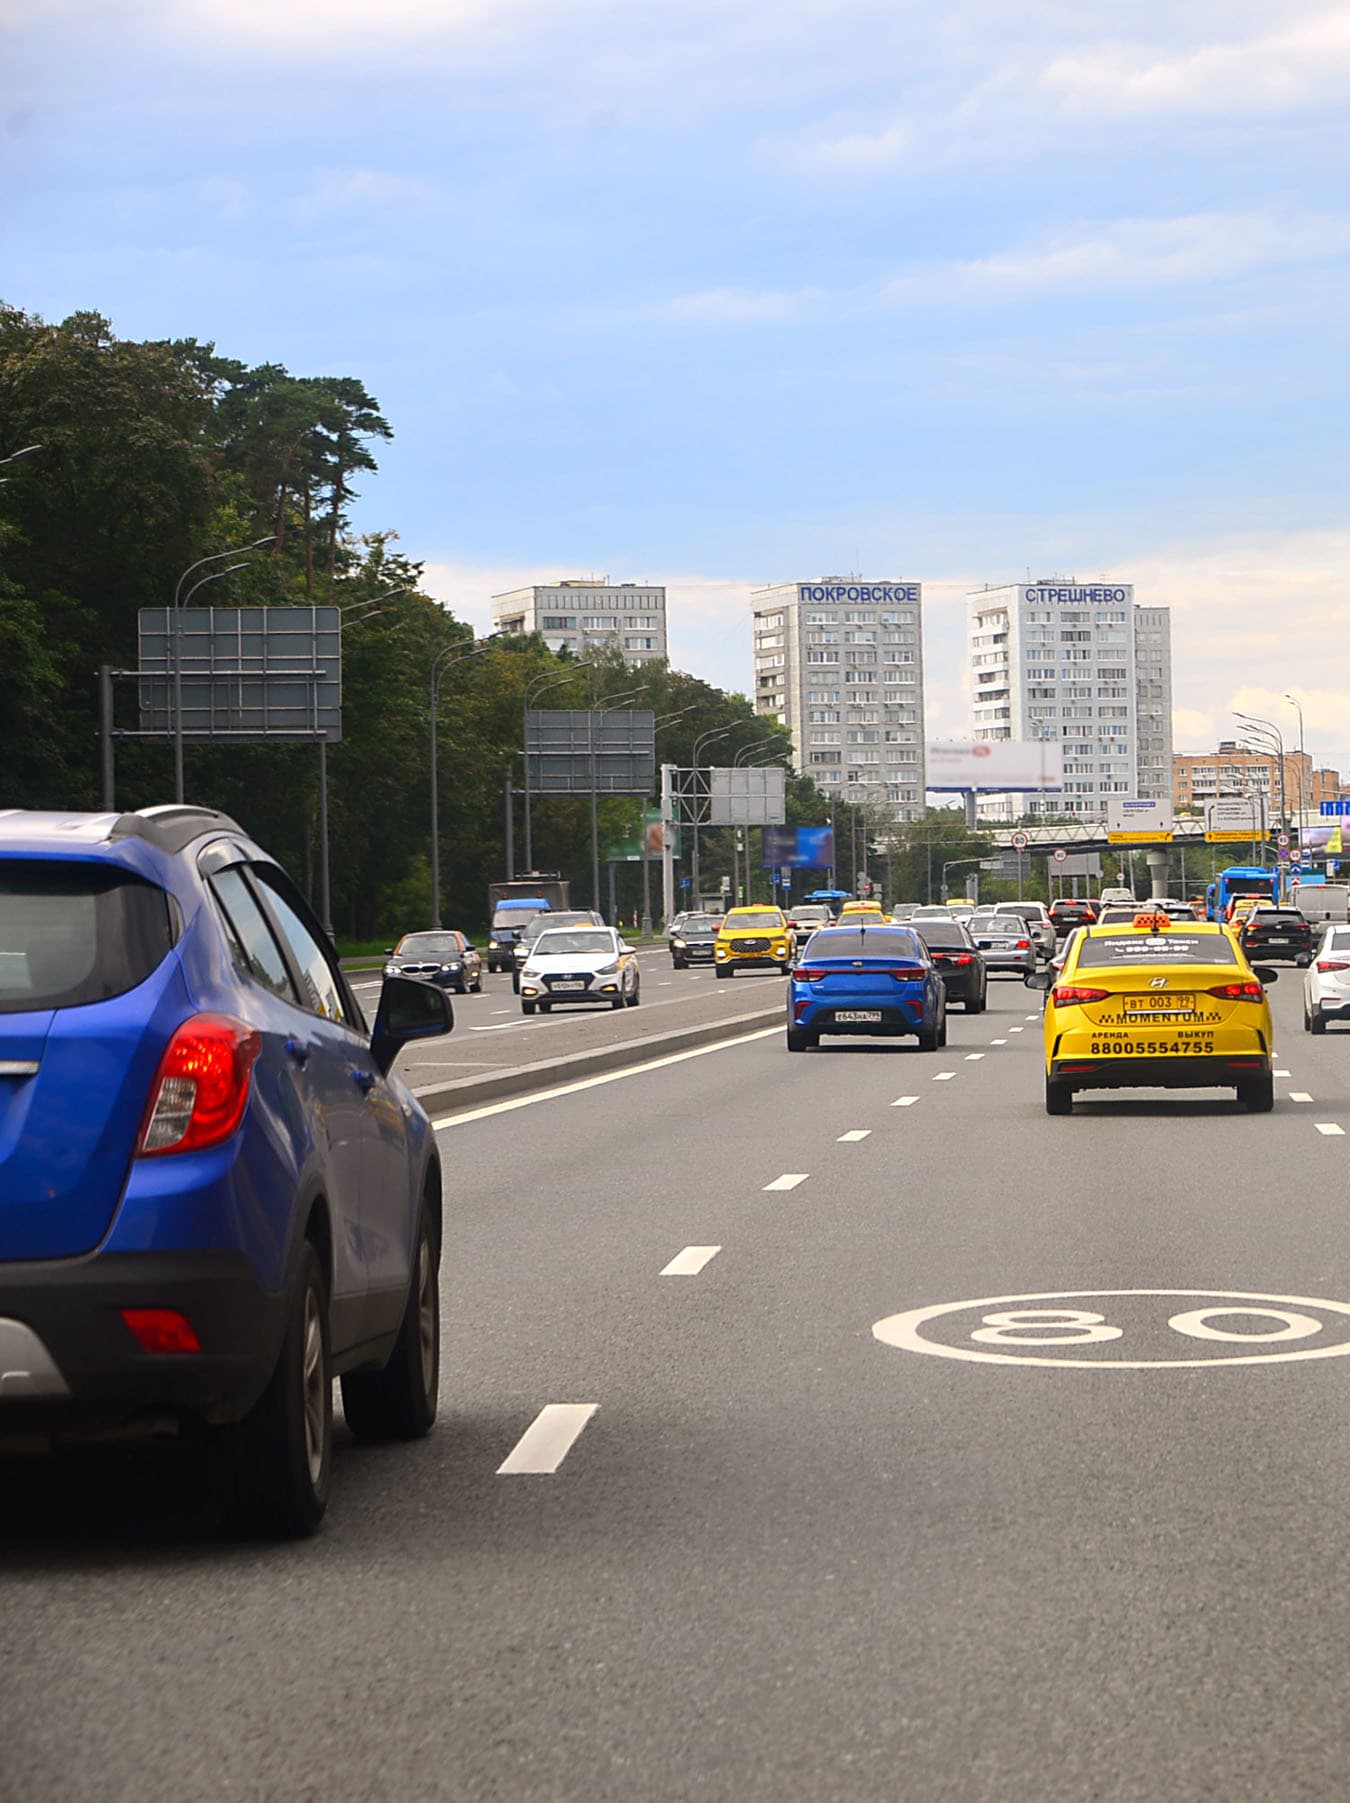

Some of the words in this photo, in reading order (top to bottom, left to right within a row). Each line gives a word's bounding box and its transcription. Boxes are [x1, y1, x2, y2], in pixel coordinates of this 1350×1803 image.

[800, 586, 917, 602] ПОКРОВСКОЕ
[1025, 588, 1126, 603] СТРЕШНЕВО
[1149, 997, 1172, 1008] 003
[1116, 1012, 1204, 1025] MOMENTUM
[1091, 1041, 1214, 1055] 88005554755
[970, 1307, 1323, 1345] 80
